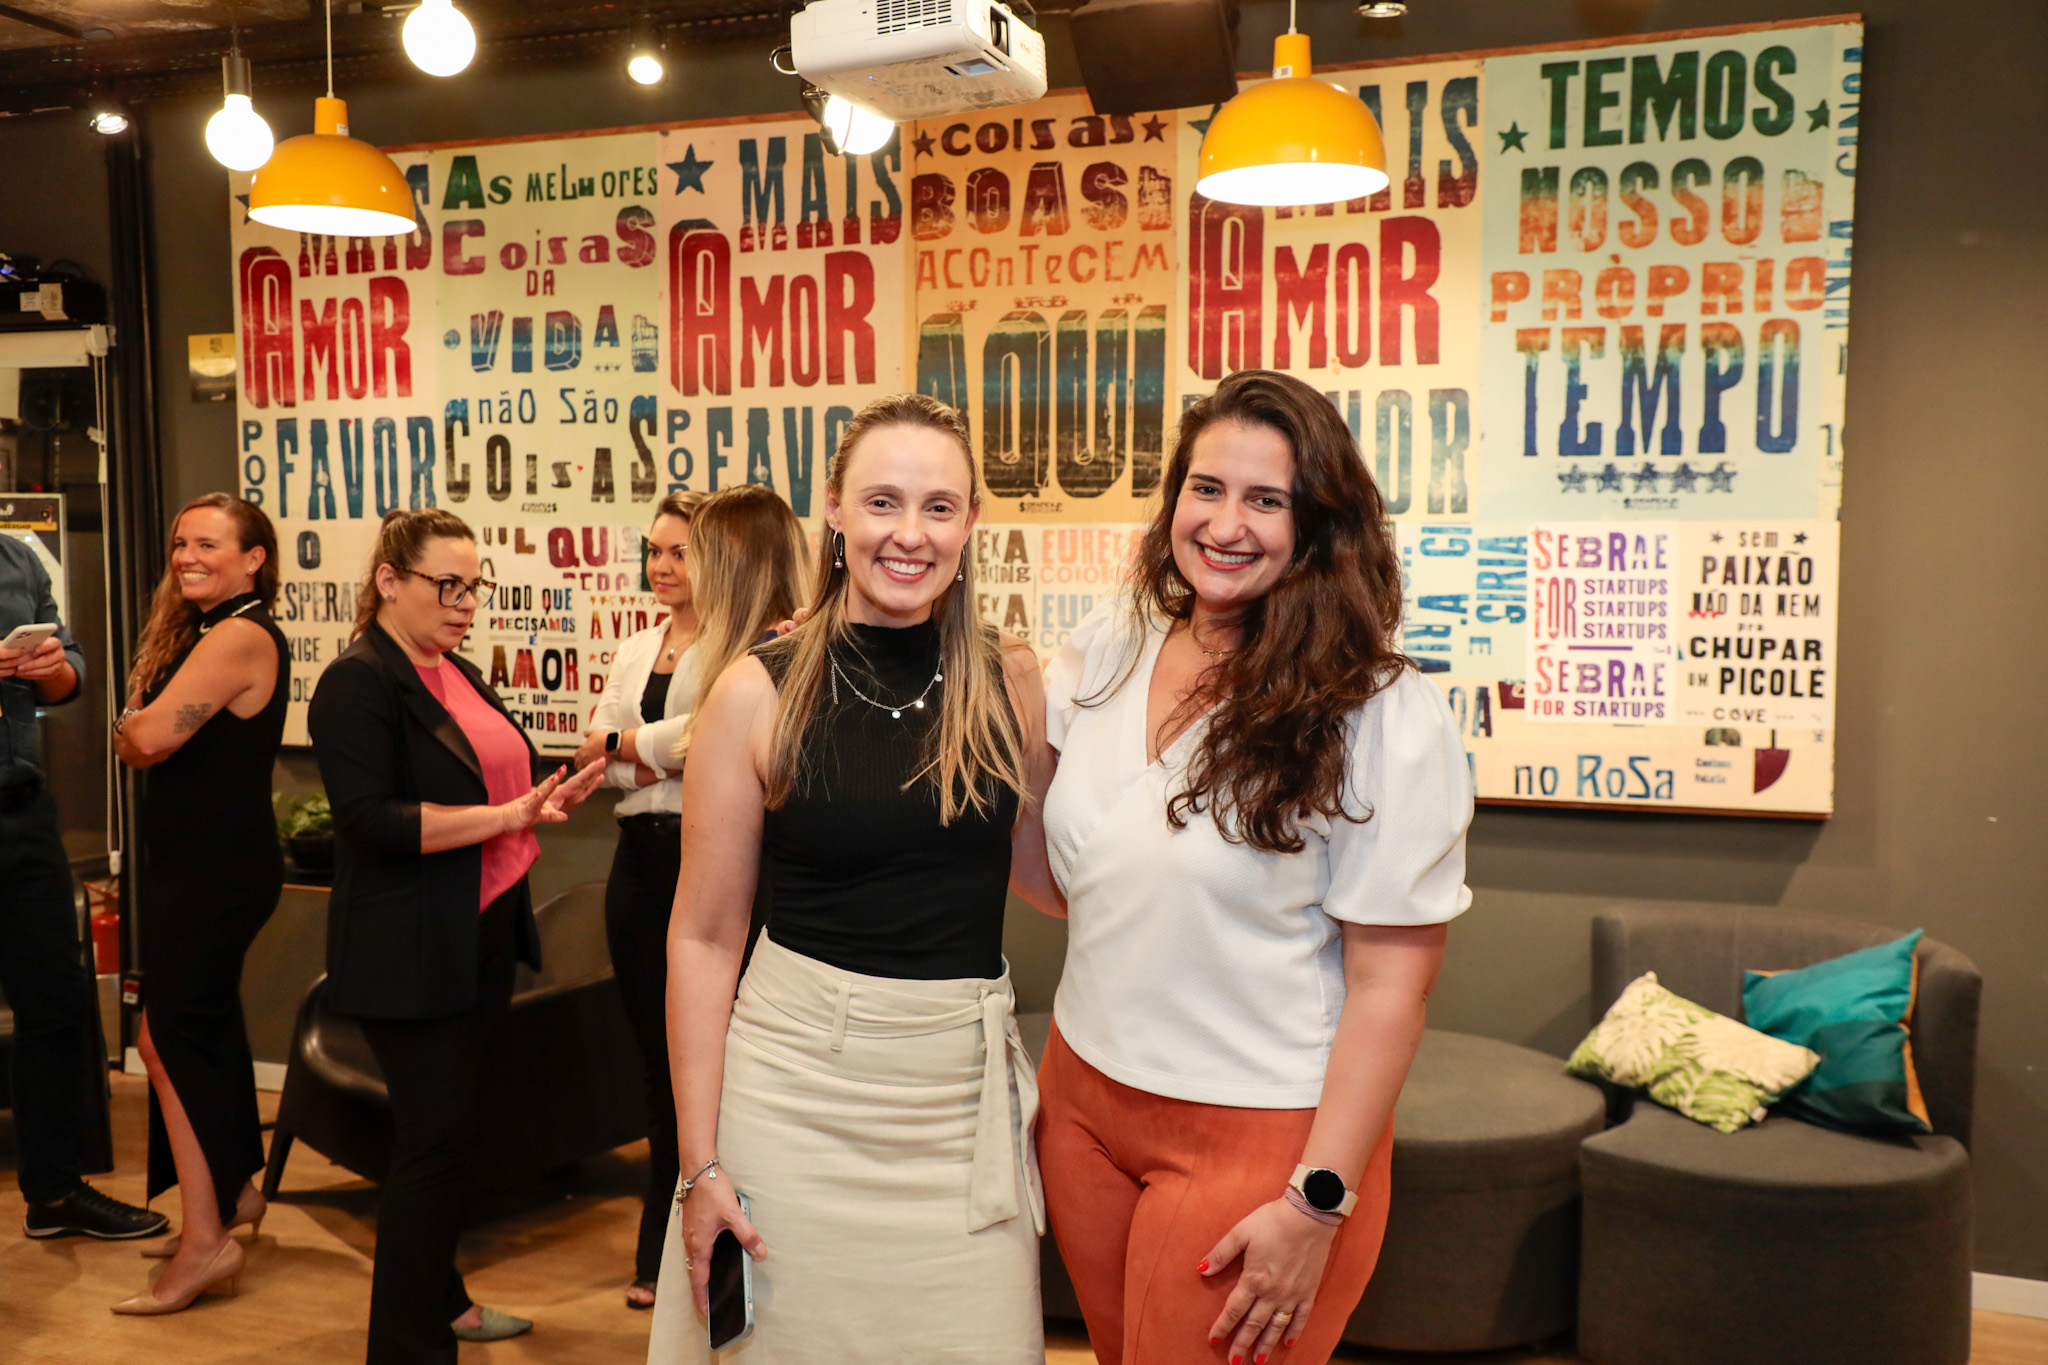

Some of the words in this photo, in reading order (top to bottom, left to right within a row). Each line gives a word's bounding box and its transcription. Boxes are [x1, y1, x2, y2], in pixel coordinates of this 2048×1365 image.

[1541, 45, 1797, 149] TEMOS
[911, 161, 1129, 241] BOAS
[1518, 156, 1765, 254] NOSSO
[526, 269, 555, 297] DA
[1188, 192, 1442, 380] AMOR
[239, 246, 413, 409] AMOR
[669, 218, 877, 396] AMOR
[470, 304, 621, 373] VIDA
[1515, 318, 1801, 456] TEMPO
[275, 415, 438, 520] FAVOR
[297, 530, 321, 569] O
[1534, 530, 1668, 571] SEBRAE
[1702, 551, 1812, 586] PAIXÃO
[542, 588, 573, 615] QUE
[1583, 578, 1668, 595] STARTUPS
[1777, 593, 1820, 617] NEM
[489, 616, 576, 633] PRECISAMOS
[1534, 576, 1576, 639] FOR
[1583, 601, 1667, 617] STARTUPS
[1583, 623, 1667, 639] STARTUPS
[1690, 636, 1822, 661] CHUPAR
[490, 644, 579, 691] AMOR
[1534, 656, 1666, 697] SEBRAE
[1534, 699, 1565, 716] FOR
[1573, 700, 1665, 718] STARTUPS
[1515, 765, 1559, 796] no
